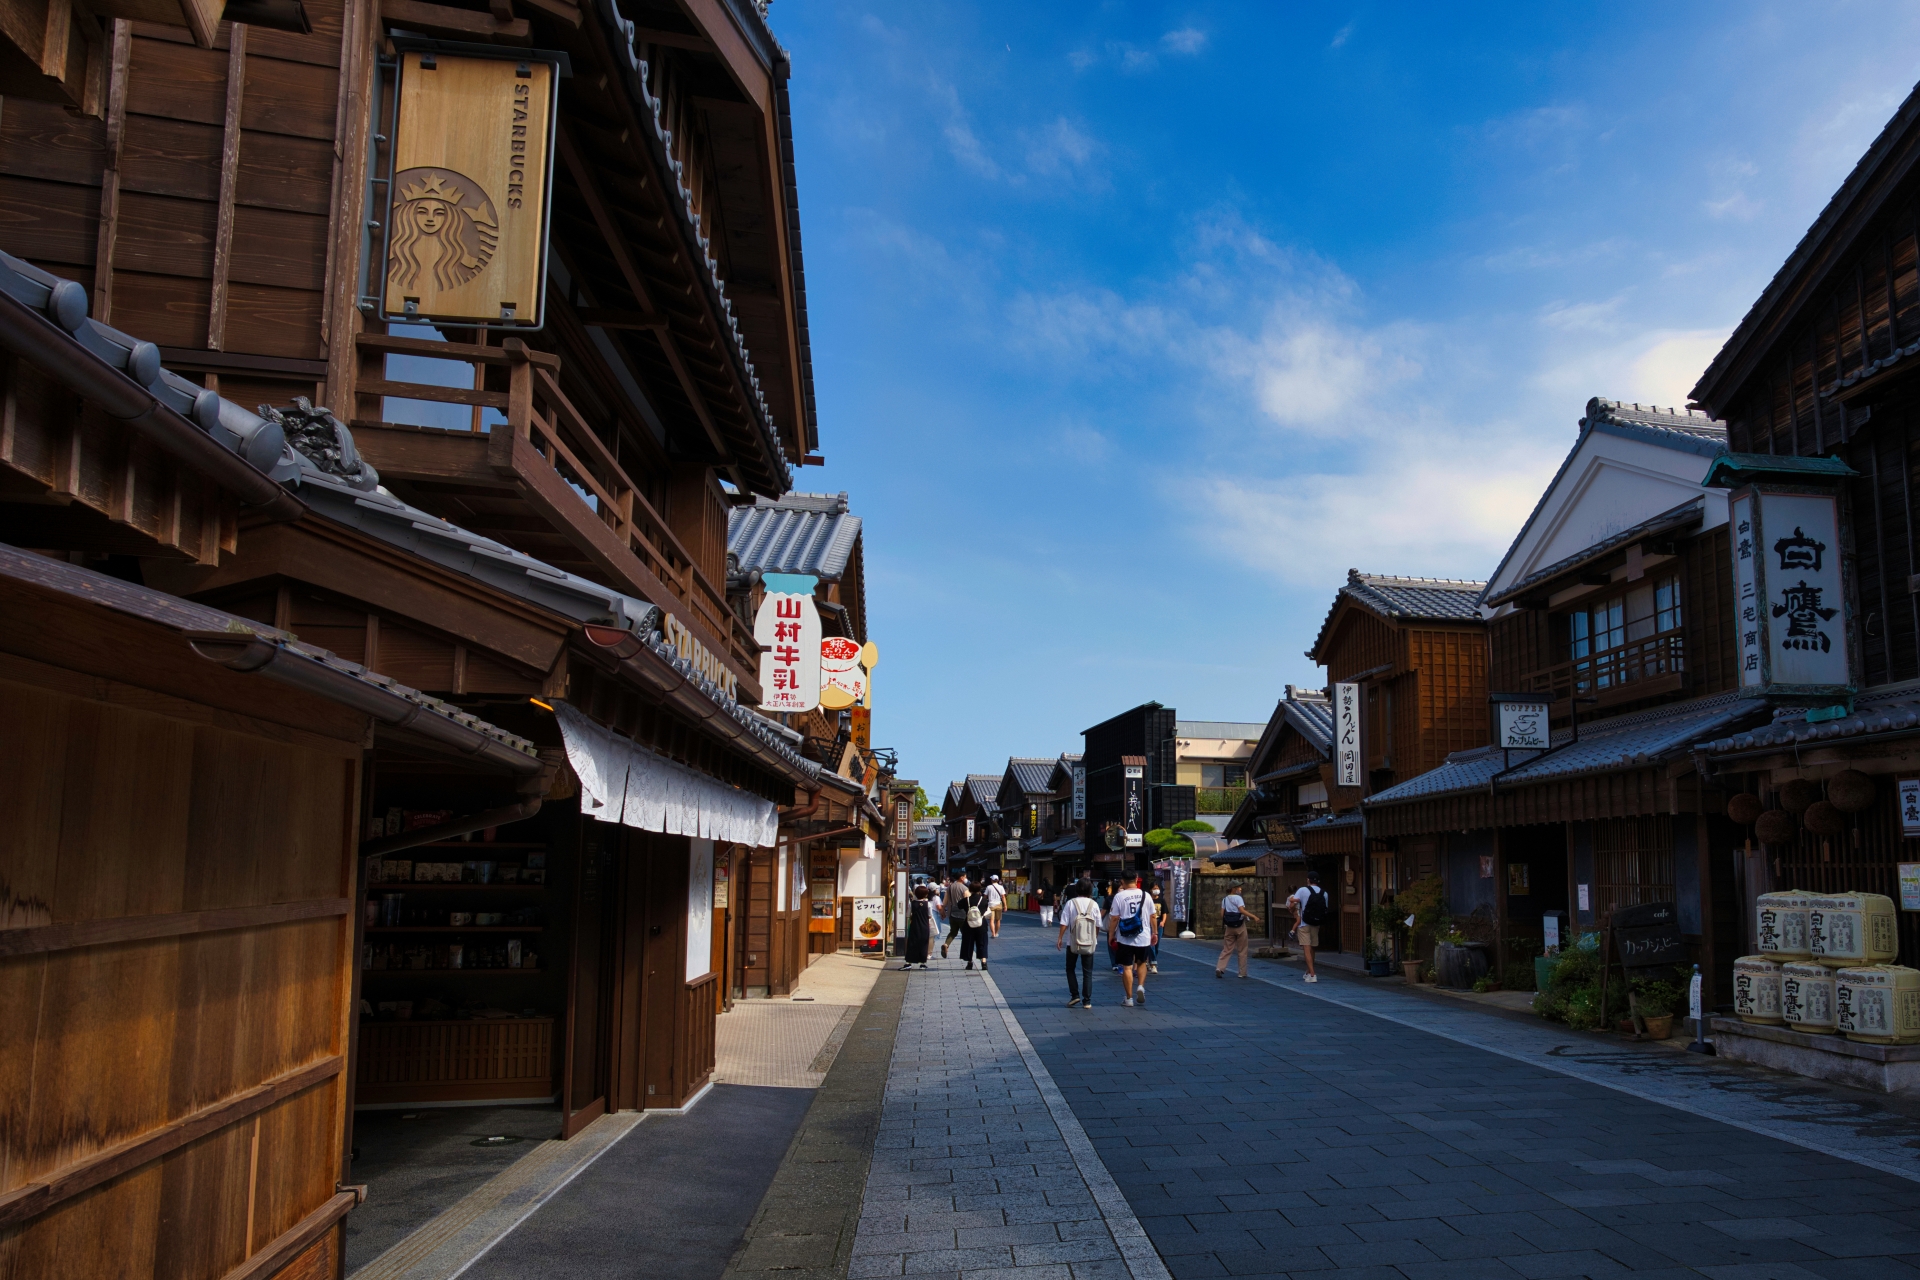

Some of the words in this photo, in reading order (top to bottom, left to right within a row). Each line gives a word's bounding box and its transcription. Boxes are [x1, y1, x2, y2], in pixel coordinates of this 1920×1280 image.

[508, 84, 529, 210] STARBUCKS
[1771, 526, 1840, 653] 白鷹
[664, 613, 737, 700] STARBUCKS
[774, 598, 802, 690] 山村牛乳
[1741, 582, 1759, 671] 三宅商店
[1342, 686, 1355, 745] 伊勢うどん
[1504, 704, 1544, 712] COFFEE
[413, 813, 442, 822] CELEBRATE
[1624, 937, 1680, 955] カップジュビー
[1653, 909, 1670, 918] cafe
